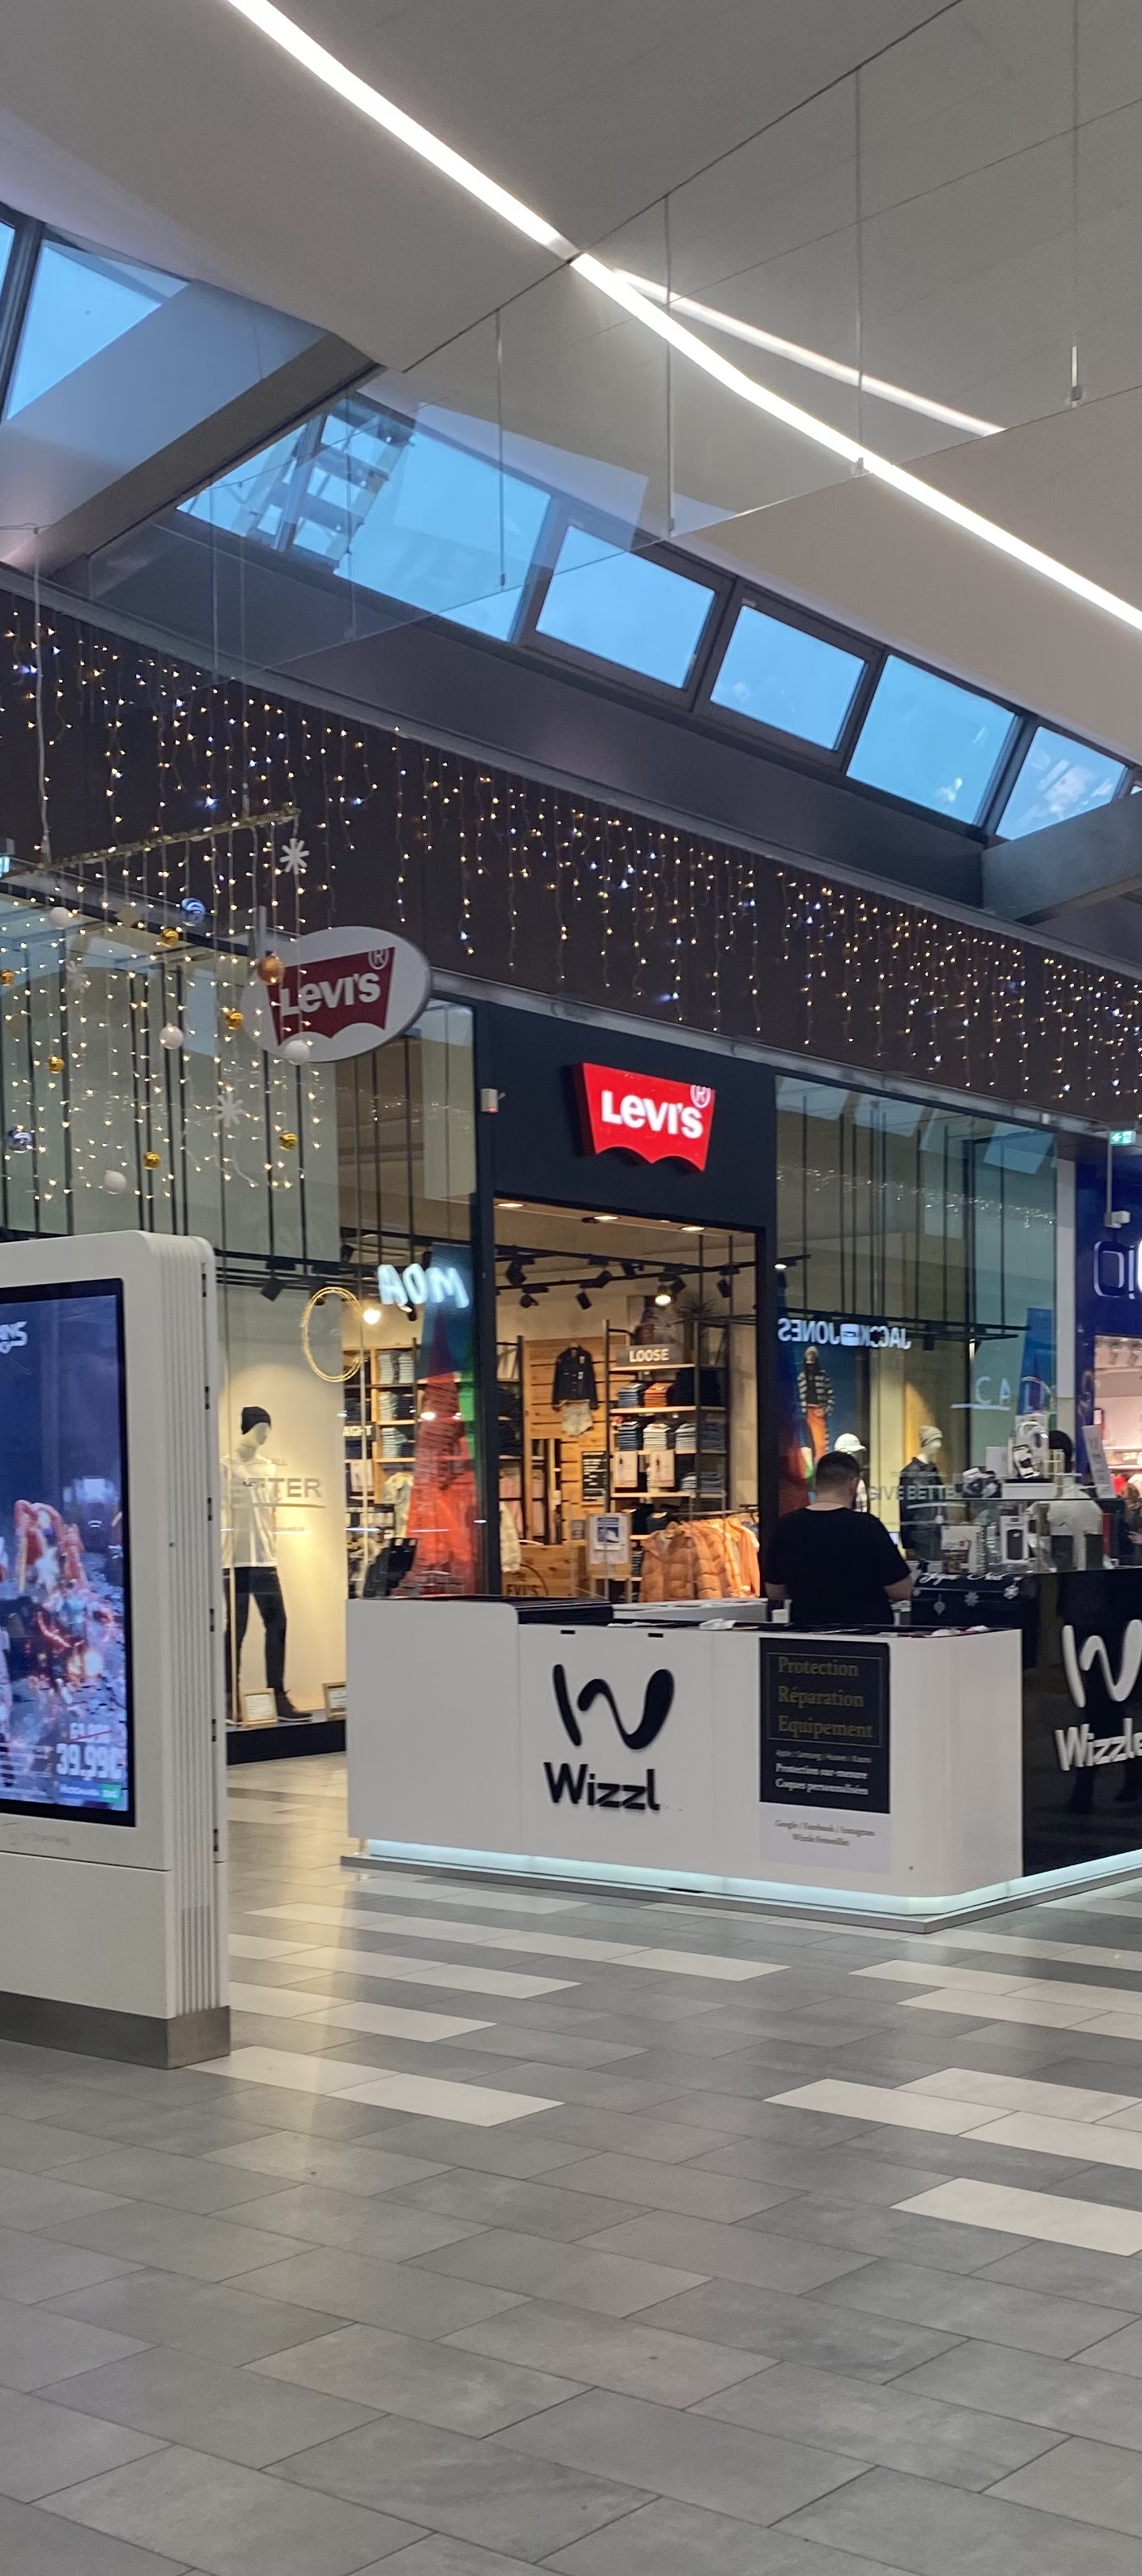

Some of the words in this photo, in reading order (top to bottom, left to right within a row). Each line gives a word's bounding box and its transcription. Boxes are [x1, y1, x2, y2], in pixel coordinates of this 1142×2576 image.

[629, 1348, 670, 1363] LOOSE
[778, 1656, 859, 1677] Protection
[778, 1685, 864, 1708] Réparation
[778, 1715, 873, 1739] Equipement
[543, 1762, 660, 1811] Wizzl
